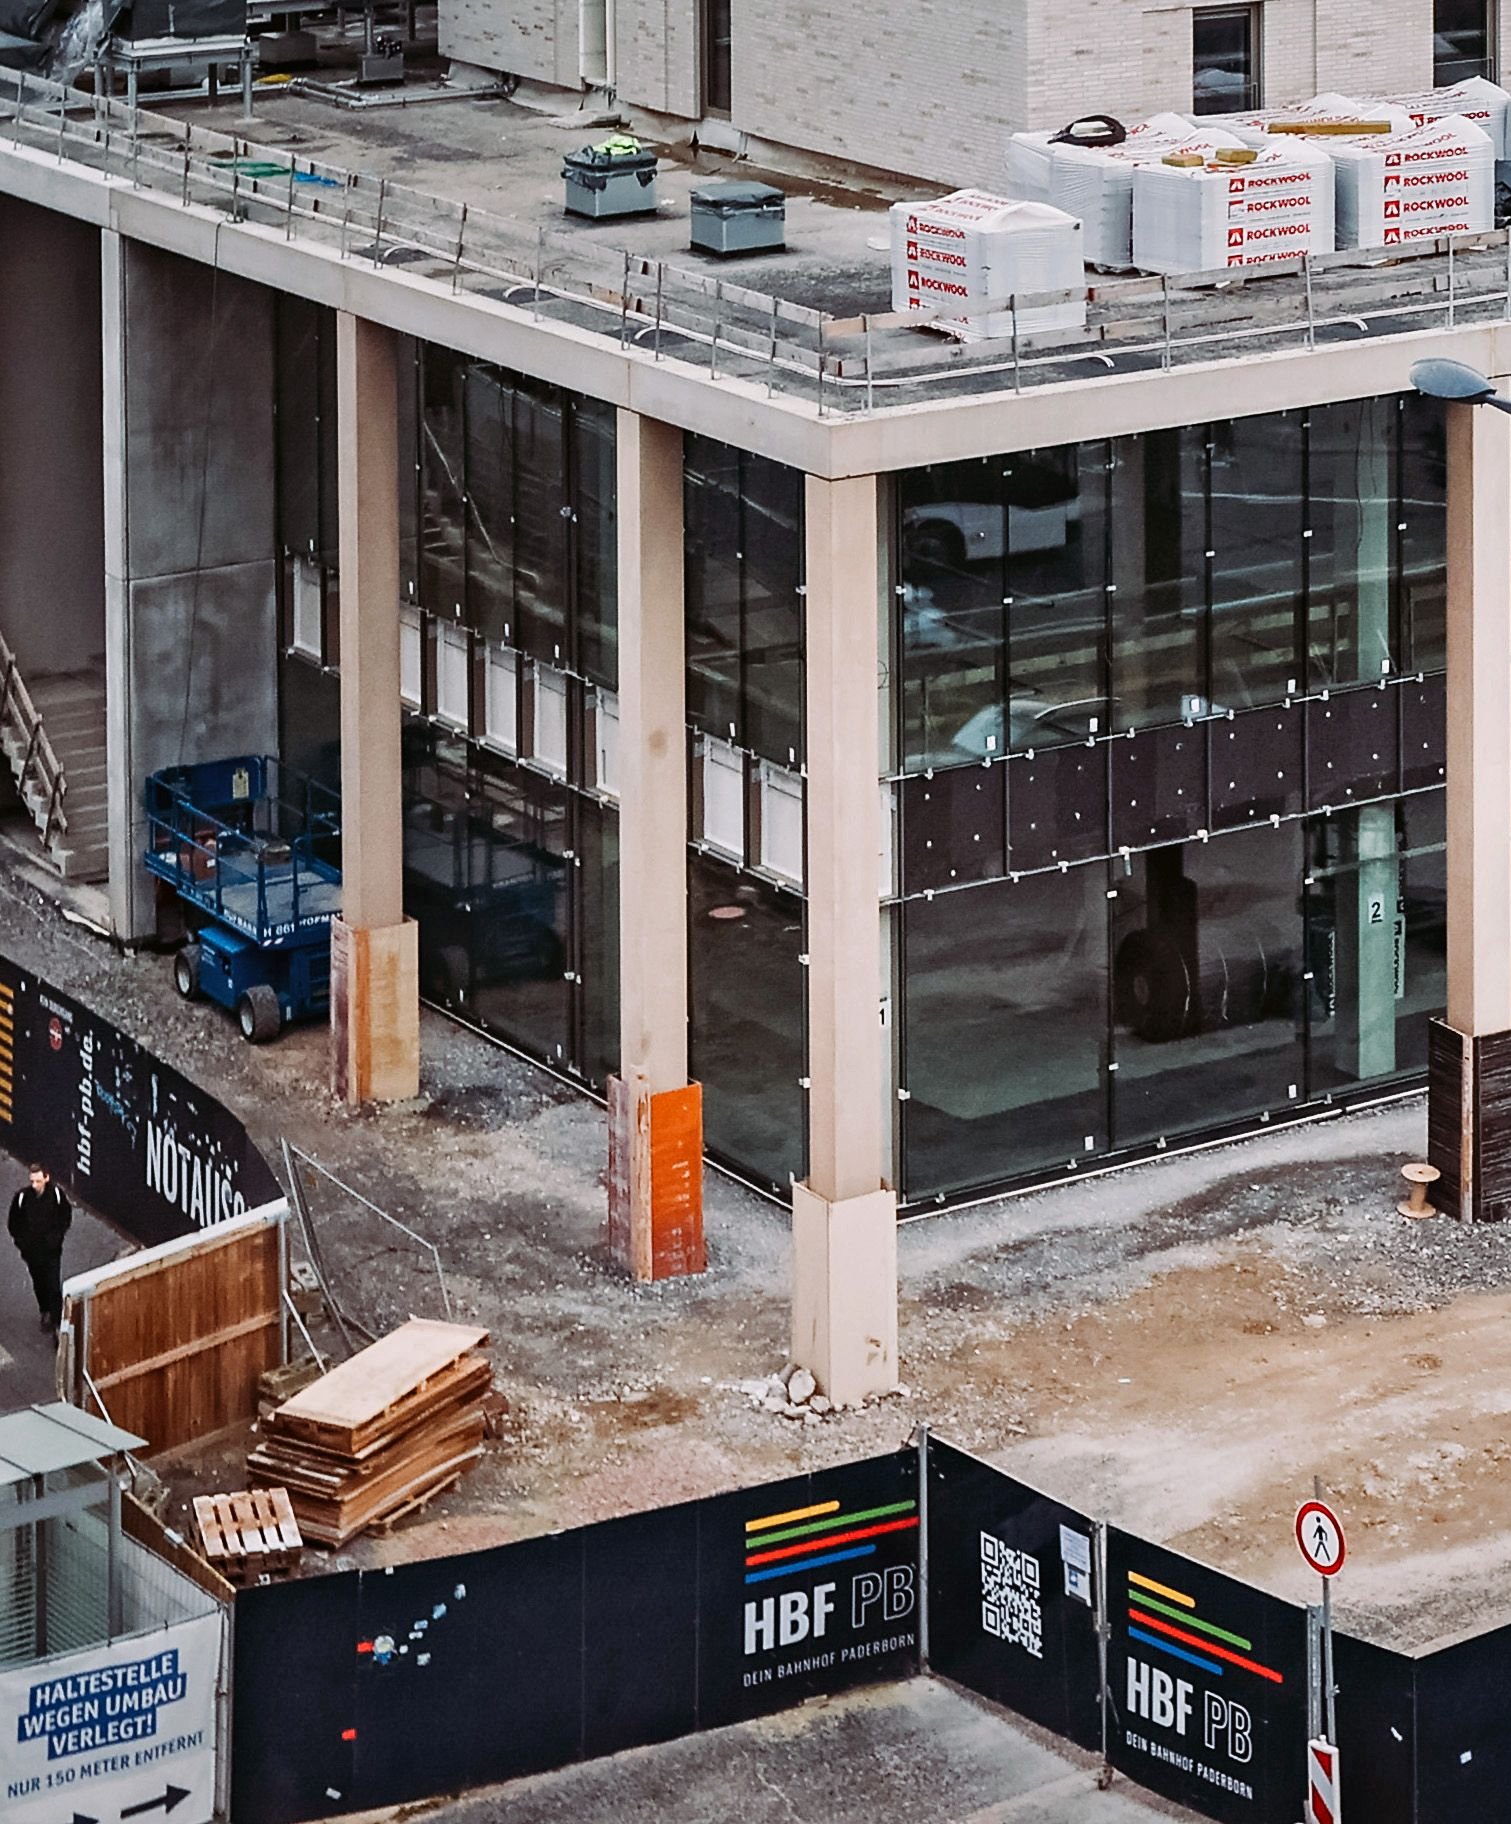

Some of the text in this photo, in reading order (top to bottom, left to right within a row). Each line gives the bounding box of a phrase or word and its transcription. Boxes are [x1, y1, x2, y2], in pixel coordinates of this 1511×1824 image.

[1405, 147, 1468, 162] ROCKWOOL
[1248, 172, 1312, 188] ROCKWOOL
[1404, 170, 1469, 187] ROCKWOOL
[1247, 196, 1311, 212] ROCKWOOL
[1403, 197, 1469, 212] ROCKWOOL
[1247, 224, 1311, 240] ROCKWOOL
[921, 276, 968, 297] ROCKWOOL
[1371, 901, 1382, 918] 2
[744, 1564, 915, 1655] HBF PB
[744, 1633, 916, 1687] DEIN BAHNHOF PADERBORN
[36, 1654, 174, 1709] HALTESTELLE
[24, 1678, 183, 1738] WEGEN UMBAU
[1127, 1656, 1253, 1764] HBF PB
[52, 1714, 154, 1755] VERLEGT!
[8, 1730, 205, 1799] NUR 150 METER ENTFERNT
[1126, 1730, 1253, 1800] DEIN BAHNHOF PADERBORN
